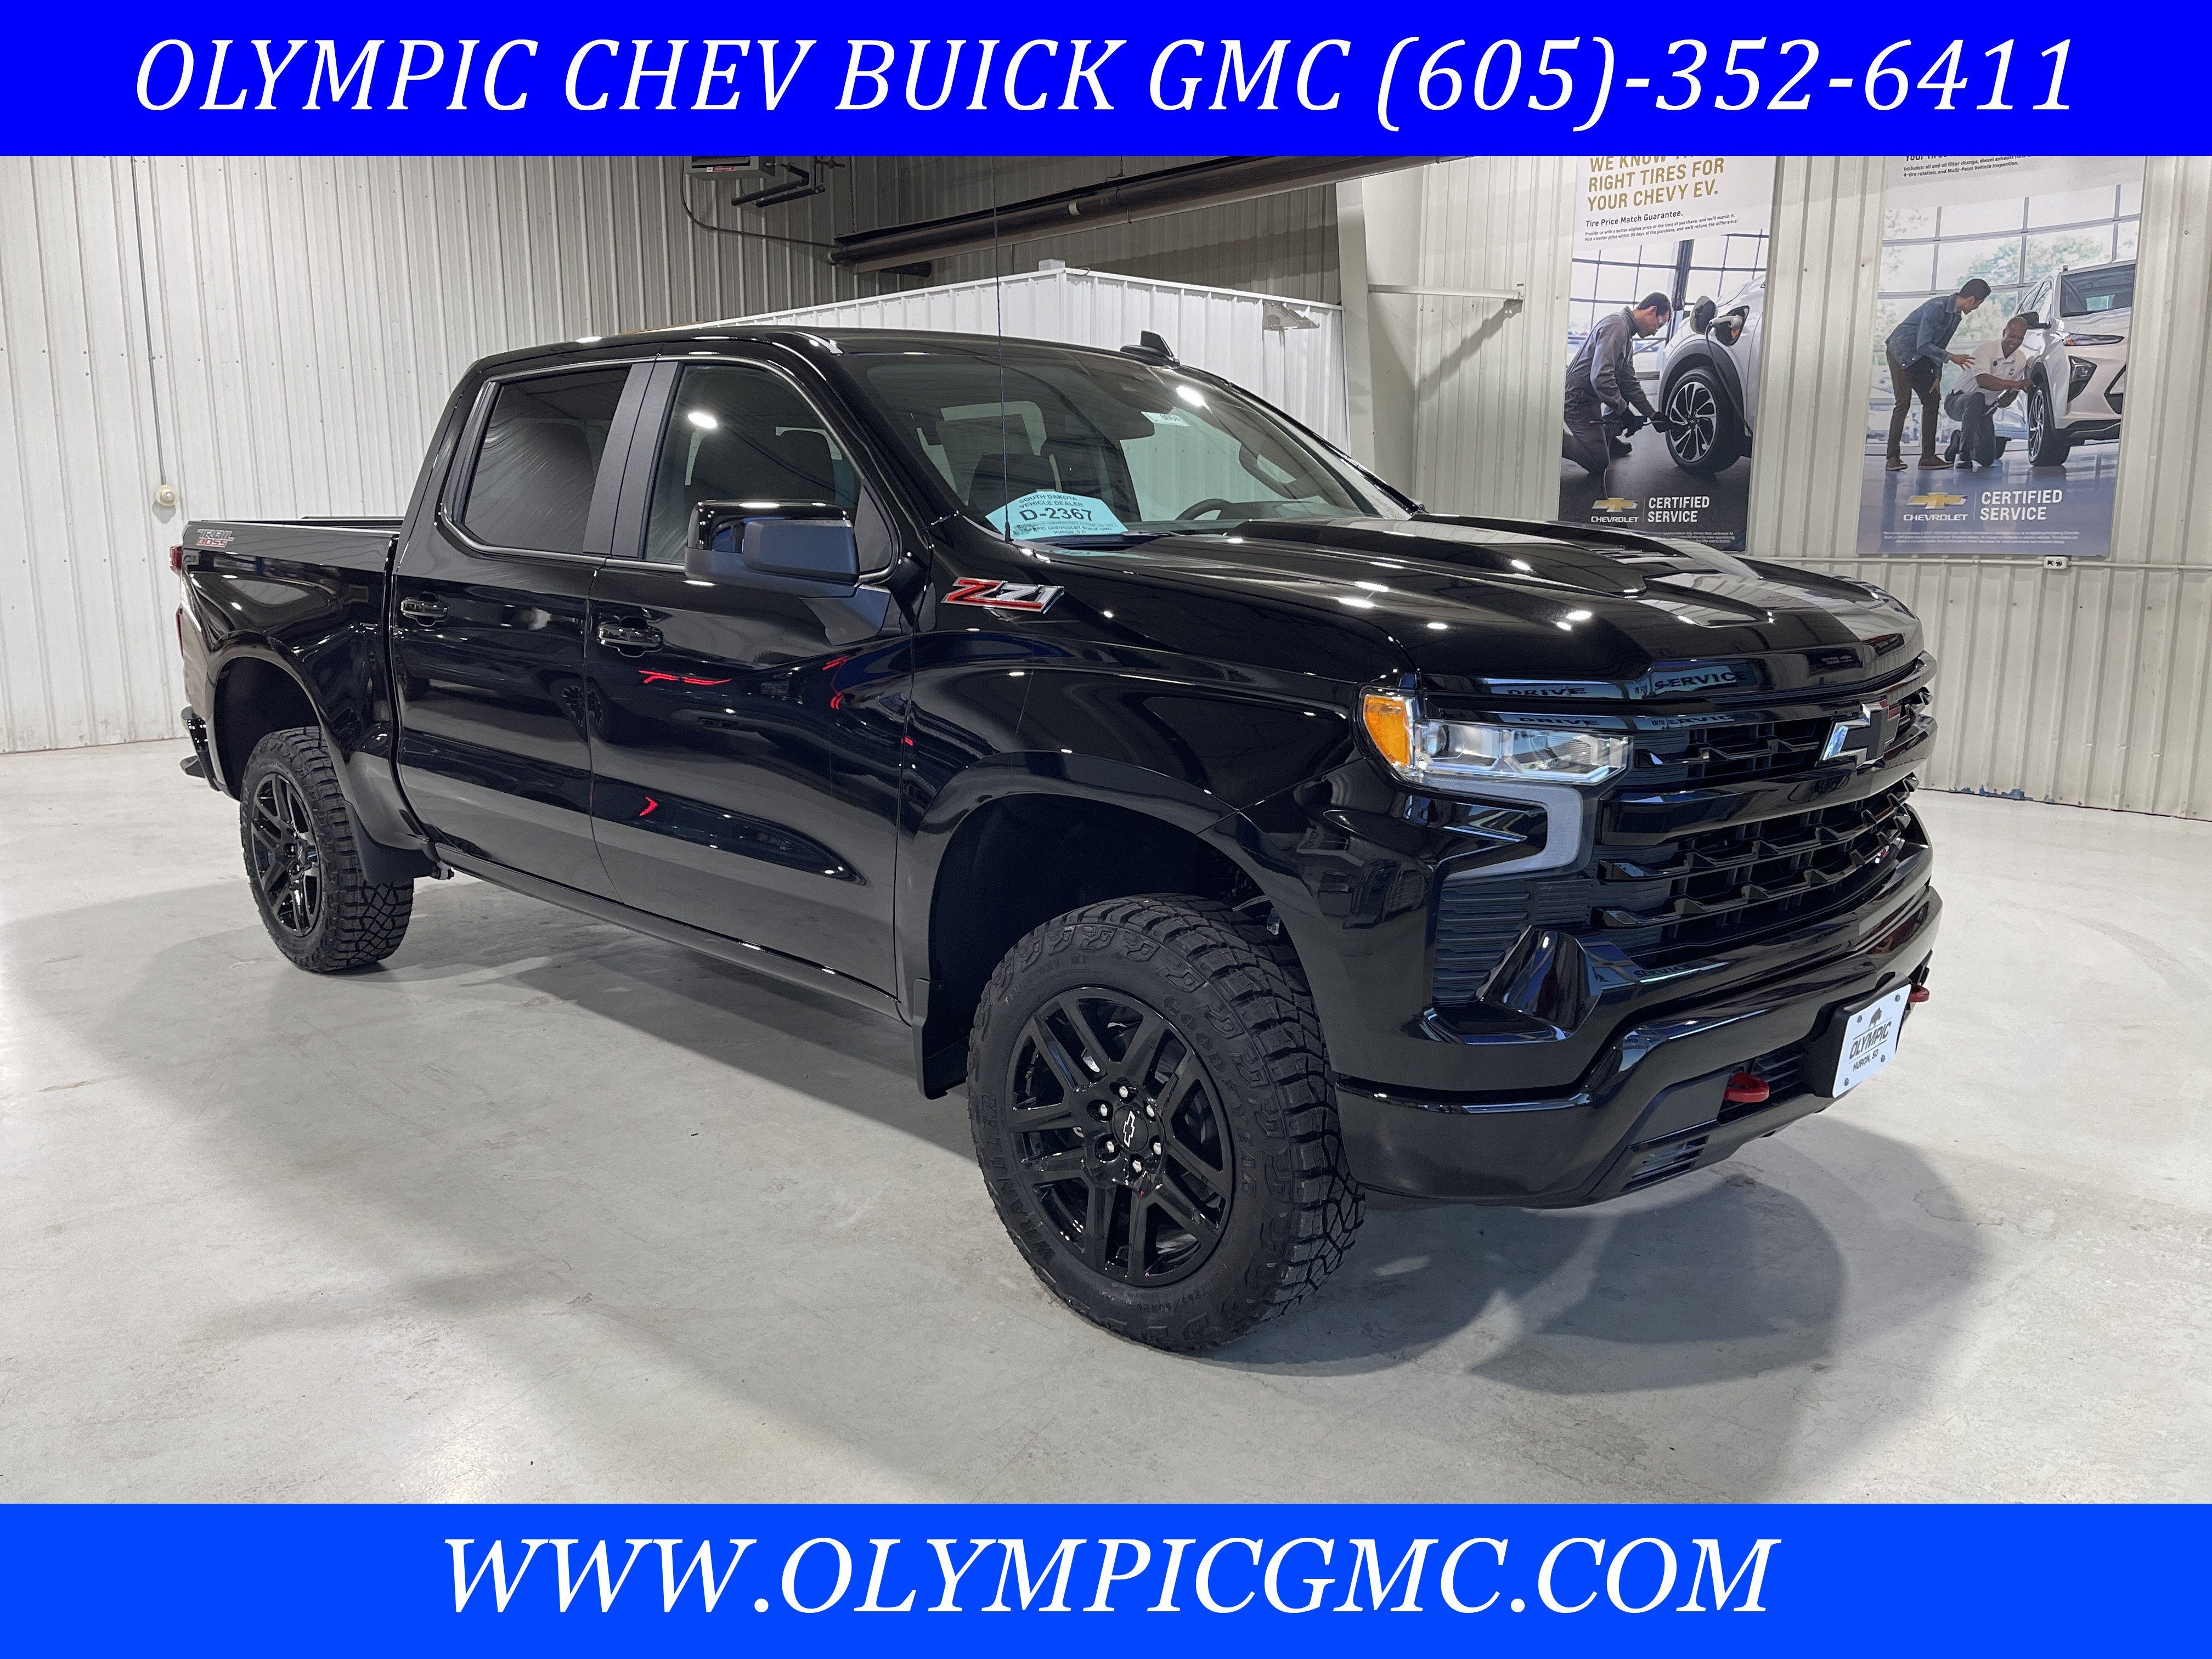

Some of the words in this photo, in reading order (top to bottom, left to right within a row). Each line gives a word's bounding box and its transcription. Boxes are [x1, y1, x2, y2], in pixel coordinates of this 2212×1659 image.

[1590, 156, 1614, 172] WE
[1589, 172, 1635, 192] RIGHT
[1640, 163, 1686, 185] TIRES
[1692, 157, 1724, 177] FOR
[1587, 193, 1628, 212] YOUR
[1633, 184, 1689, 206] CHEVY
[1694, 179, 1718, 198] EV.
[1621, 215, 1641, 224] Match
[1644, 211, 1683, 221] Guarantee.
[1019, 494, 1046, 504] SOUTH
[1649, 496, 1710, 509] CERTIFIED
[1981, 489, 2062, 505] CERTIFIED
[1019, 500, 1053, 509] VEHICLE
[1019, 507, 1092, 521] D-2367
[1647, 510, 1698, 523] SERVICE
[1979, 506, 2047, 521] SERVICE
[197, 529, 234, 541] TRAIL
[196, 538, 228, 548] BOSS
[941, 577, 1064, 612] Z71
[1655, 671, 1747, 691] SERVICE
[1519, 717, 1600, 726] DRIVE
[1849, 1022, 1892, 1059] OLYMPIC
[1872, 1049, 1879, 1059] SD
